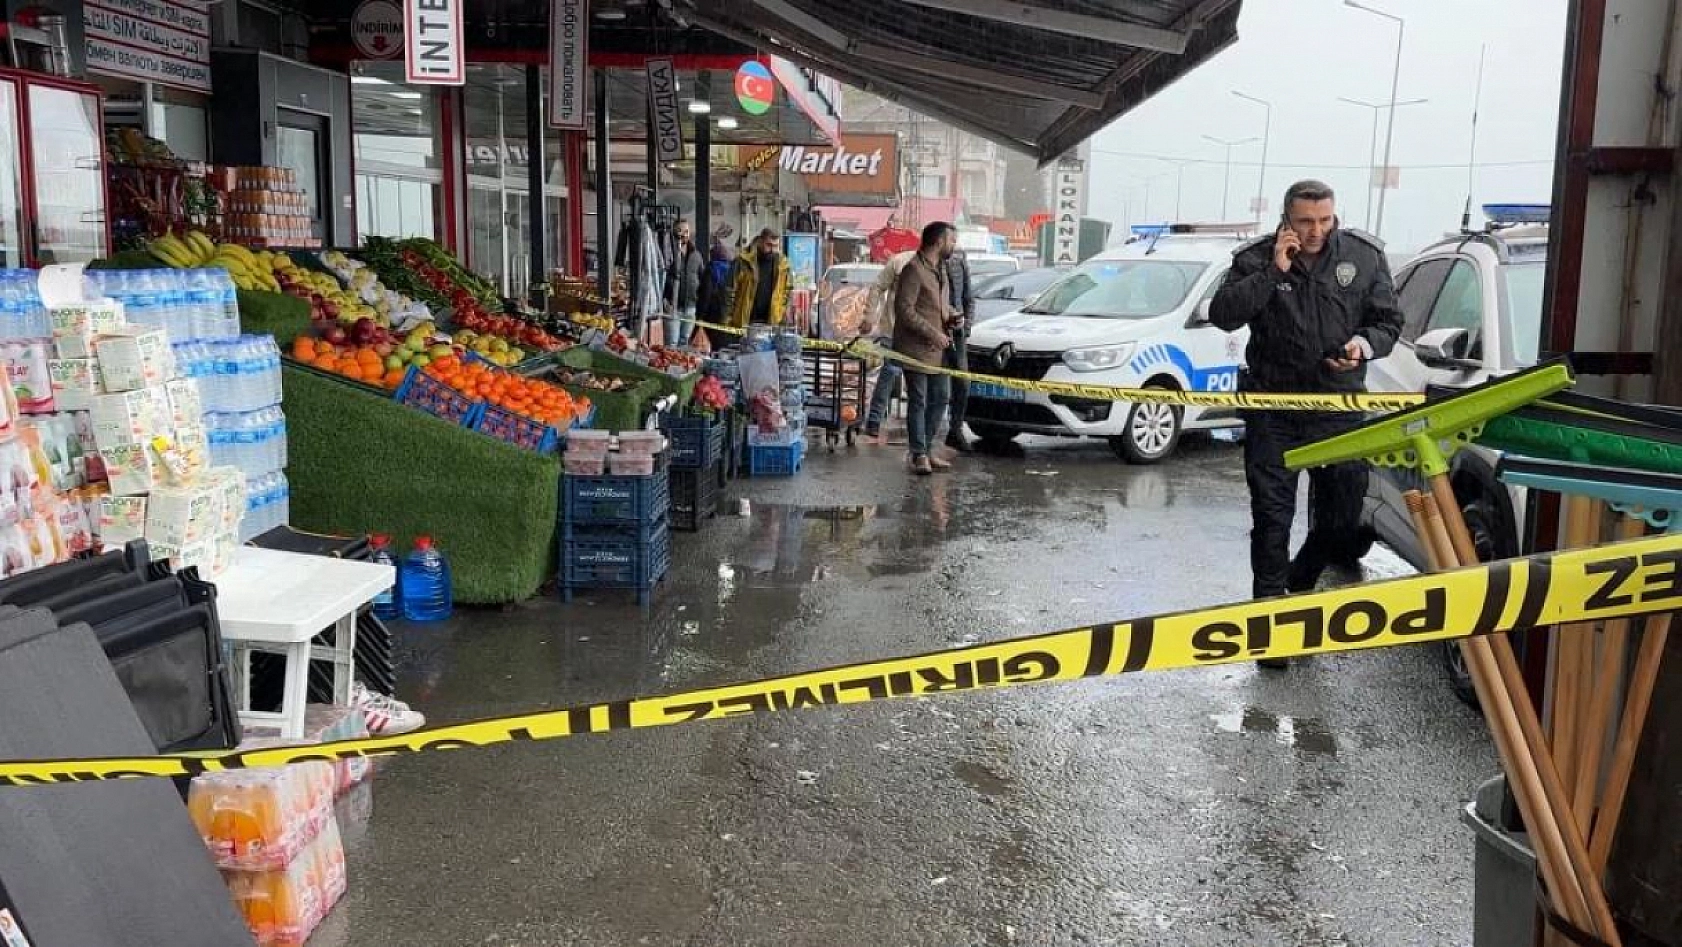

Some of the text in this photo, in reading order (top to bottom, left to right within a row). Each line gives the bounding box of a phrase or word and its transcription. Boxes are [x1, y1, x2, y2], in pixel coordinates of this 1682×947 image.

[113, 15, 137, 38] SIM
[652, 67, 679, 153] СКИДКА
[779, 145, 882, 176] Market
[1058, 174, 1077, 261] LOKANTA
